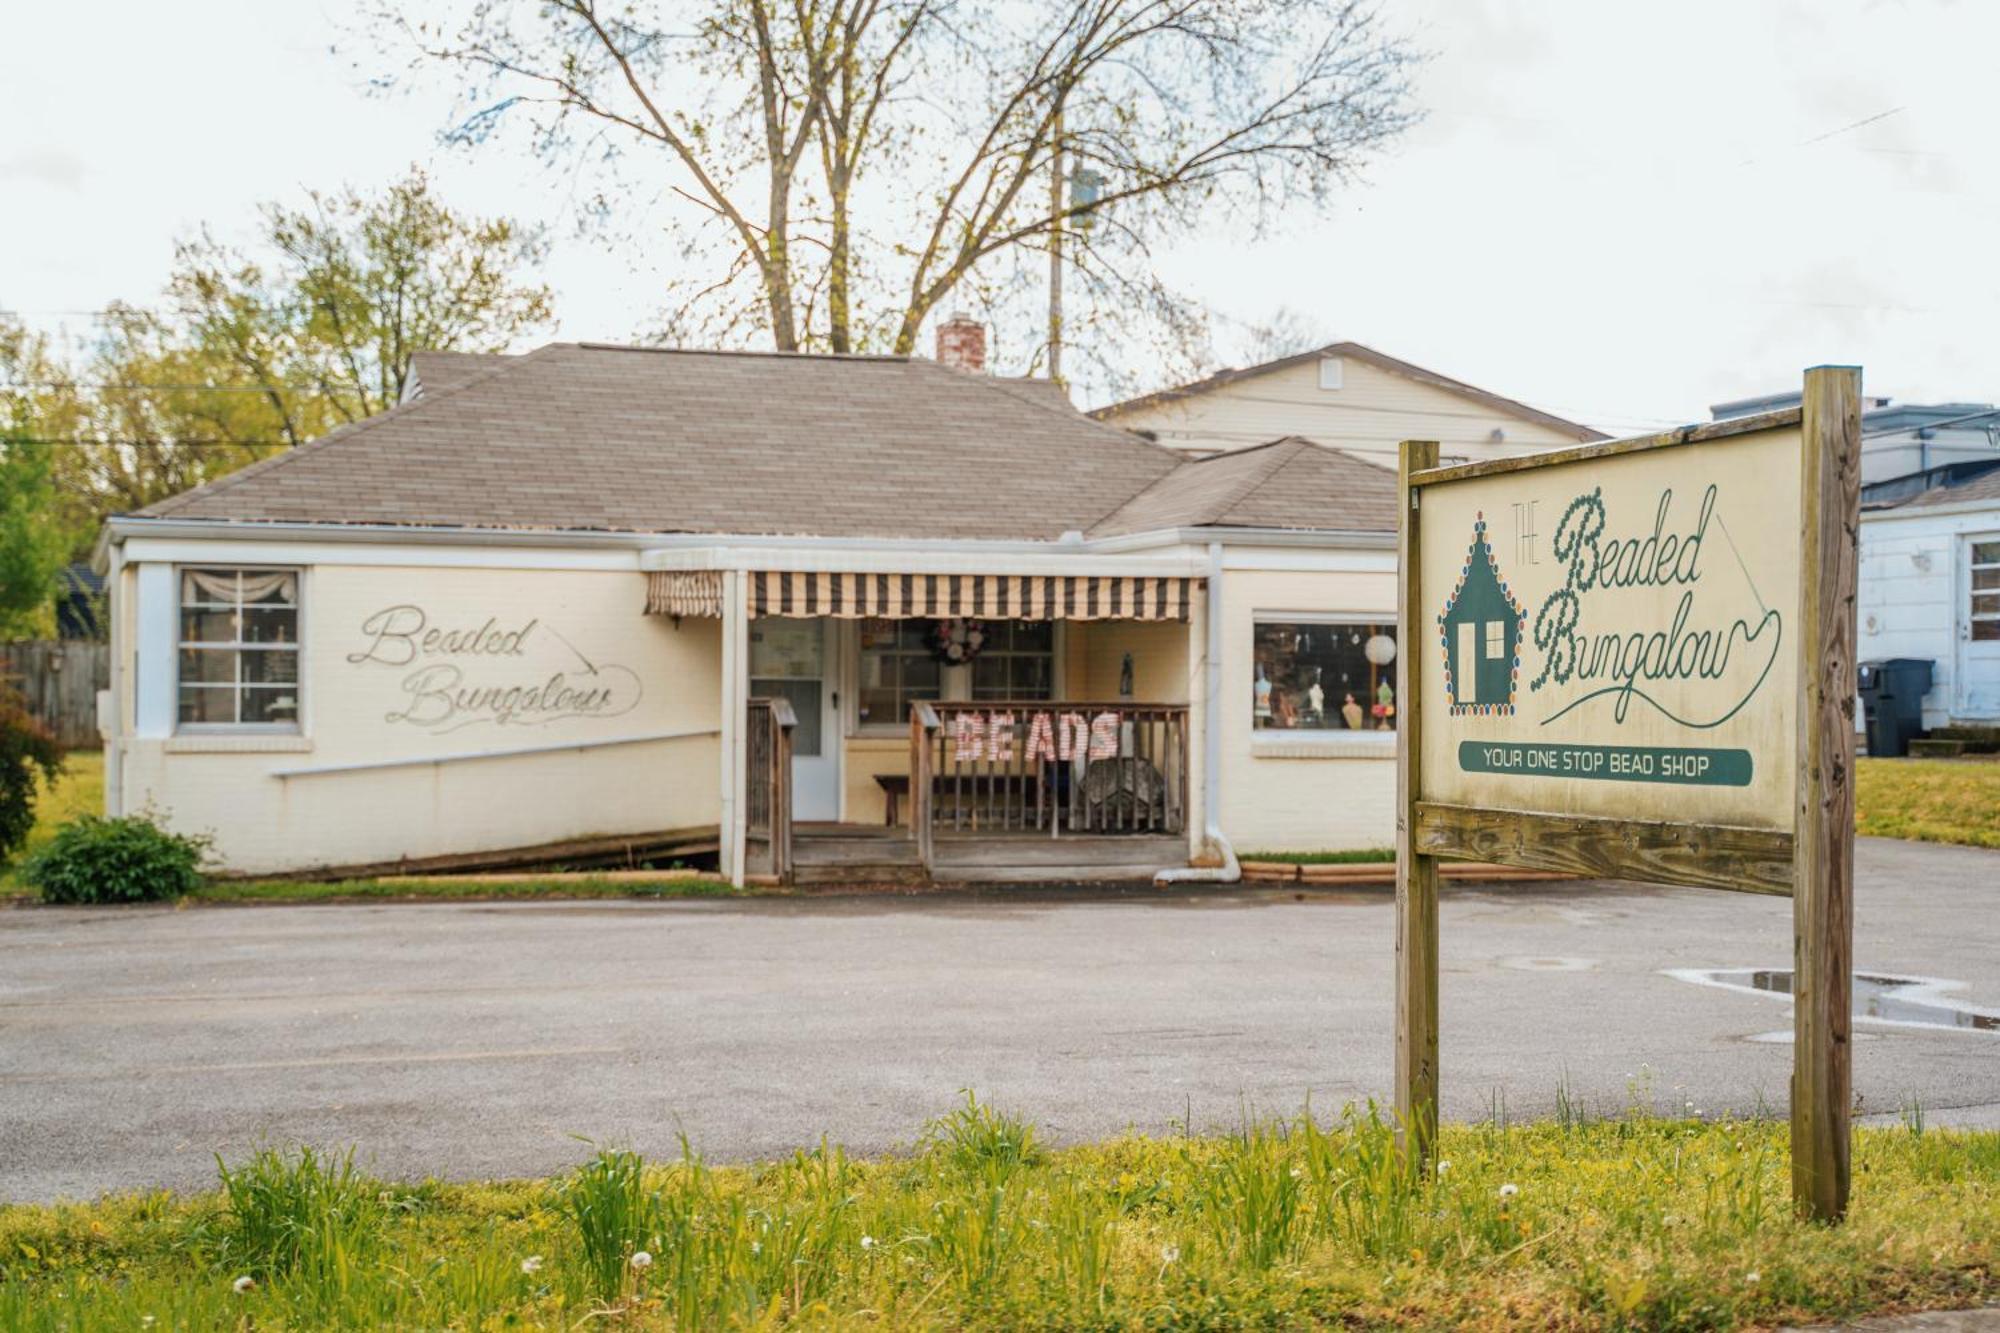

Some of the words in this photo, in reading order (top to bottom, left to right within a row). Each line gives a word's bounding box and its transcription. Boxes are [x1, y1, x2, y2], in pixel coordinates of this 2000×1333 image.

[1511, 500, 1540, 566] THE
[1553, 484, 1718, 591] Beaded
[346, 604, 538, 666] Beaded
[1530, 590, 1724, 725] Bungalow
[384, 663, 611, 726] Bungalow
[955, 712, 1120, 762] BEADS
[1483, 747, 1523, 768] YOUR
[1527, 749, 1558, 770] ONE
[1563, 751, 1604, 772] STOP
[1610, 754, 1654, 775] BEAD
[1661, 756, 1709, 777] SHOP
